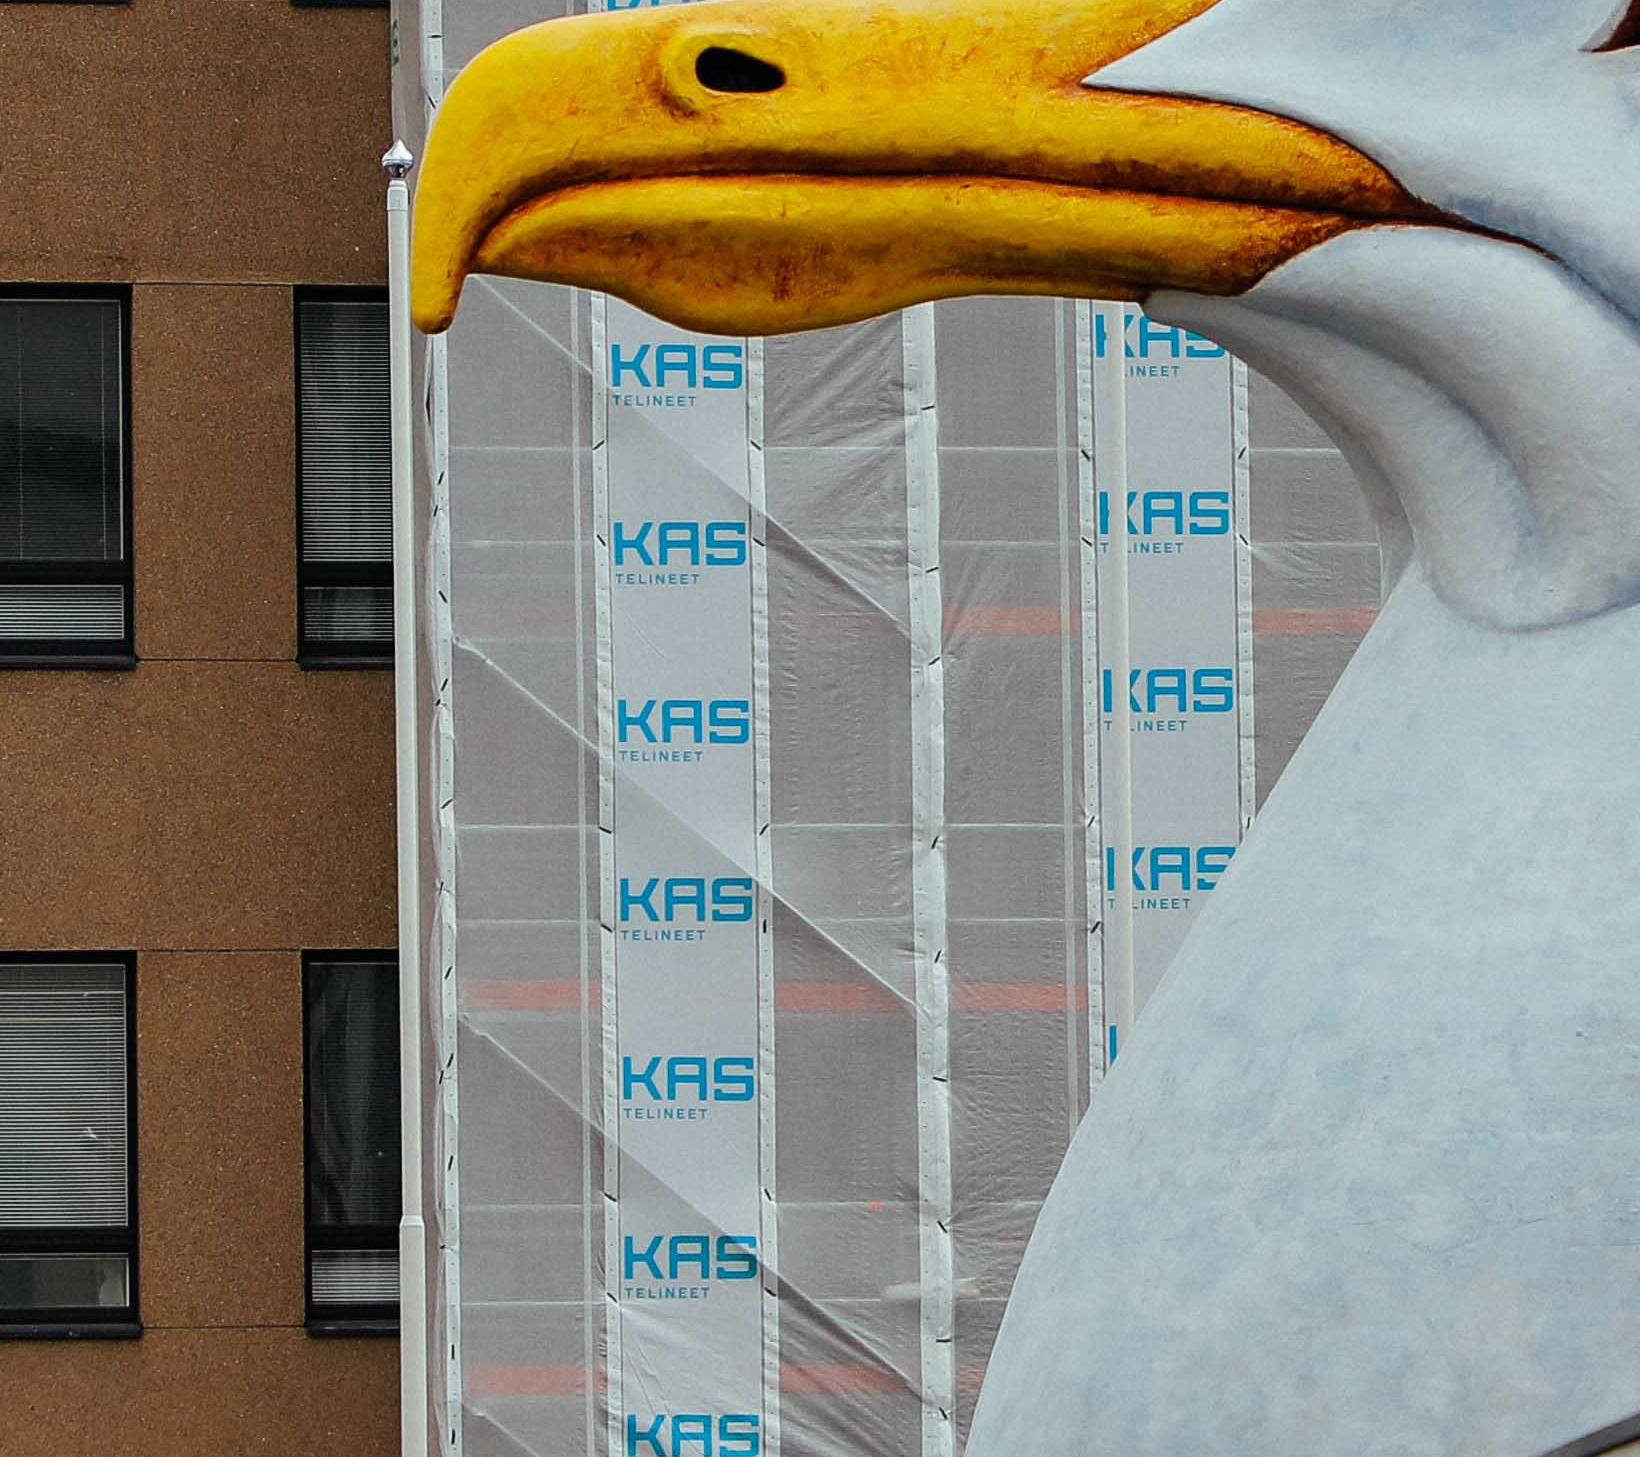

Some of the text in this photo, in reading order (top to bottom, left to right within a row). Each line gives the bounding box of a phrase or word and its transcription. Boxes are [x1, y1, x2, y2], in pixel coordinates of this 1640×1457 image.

[611, 344, 743, 389] KAS
[612, 393, 697, 408] TELINEET
[614, 522, 746, 565] KAS
[615, 569, 700, 584] TELINEET
[618, 700, 749, 744] KAS
[619, 748, 704, 763] TELINEET
[620, 878, 752, 922] KAS
[621, 926, 706, 941] TELINEET
[623, 1056, 754, 1101] KAS
[624, 1105, 709, 1120] TELINEET
[624, 1236, 757, 1279] KAS
[625, 1283, 710, 1298] TELINEET
[627, 1414, 759, 1457] KAS
